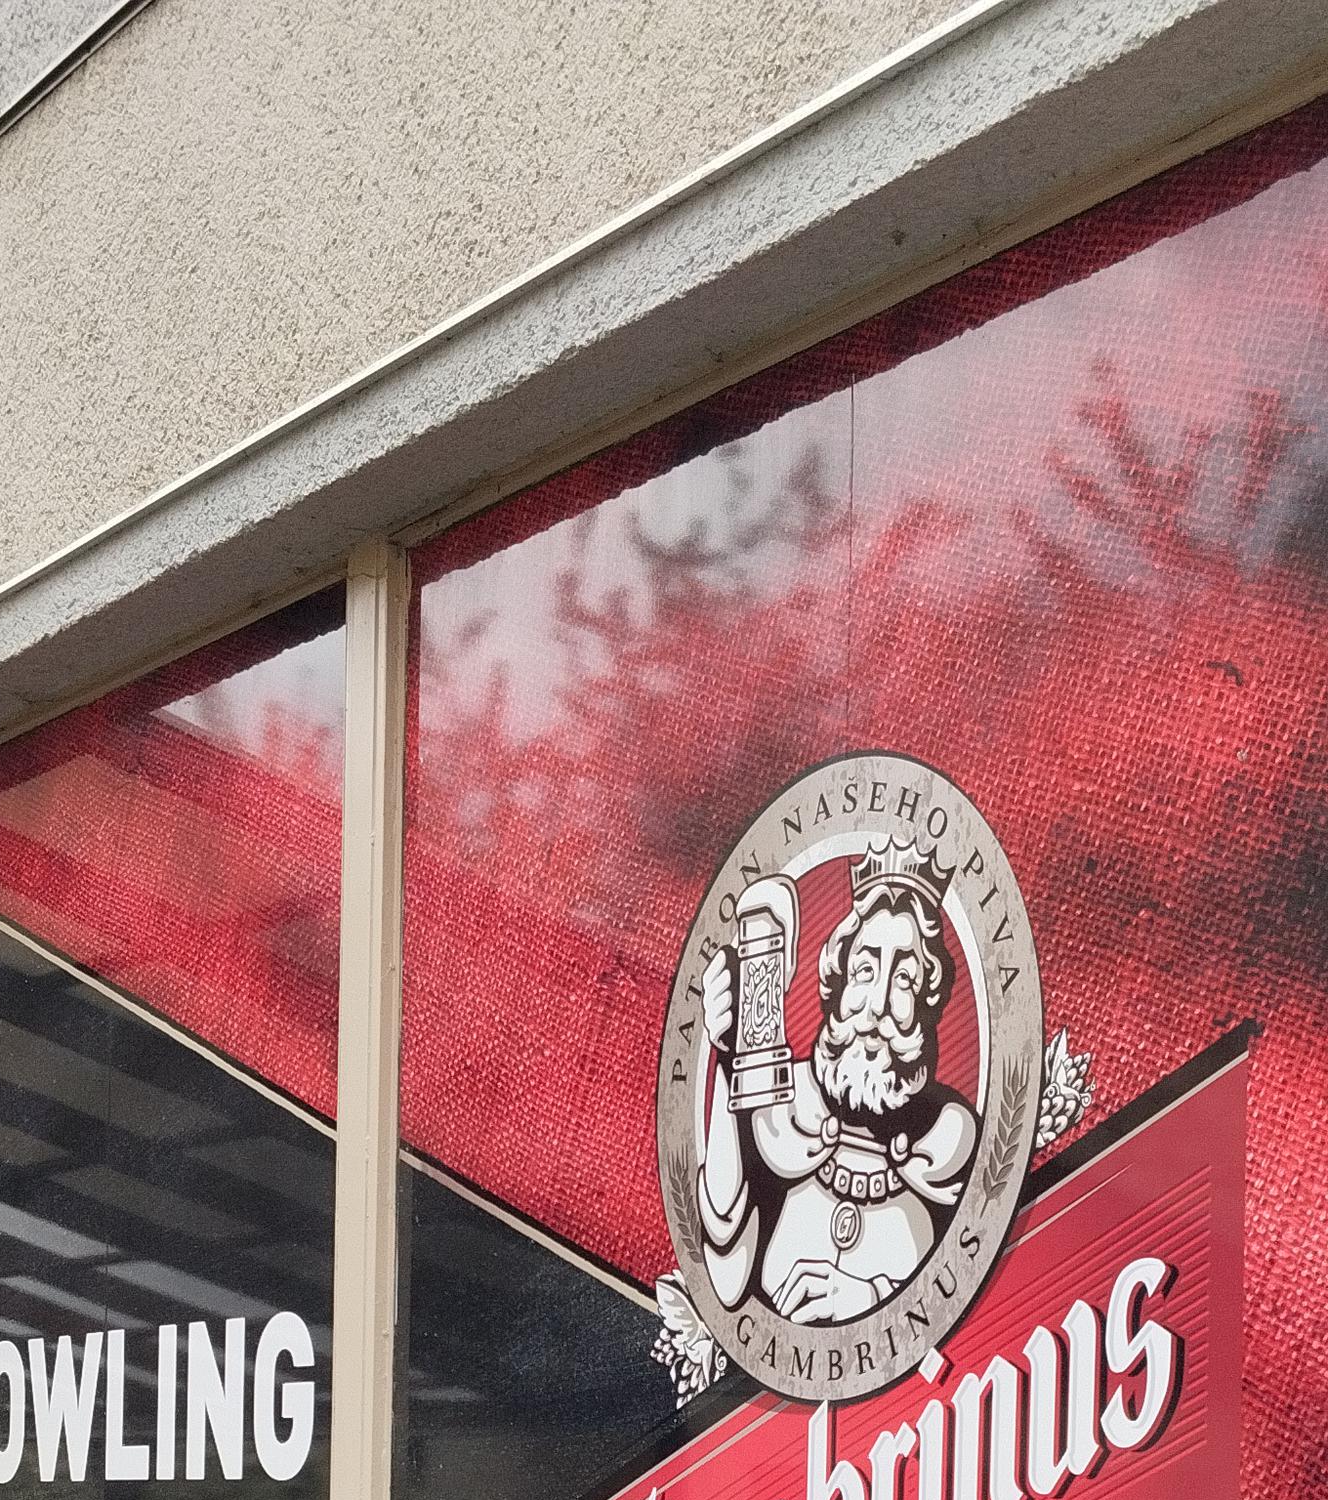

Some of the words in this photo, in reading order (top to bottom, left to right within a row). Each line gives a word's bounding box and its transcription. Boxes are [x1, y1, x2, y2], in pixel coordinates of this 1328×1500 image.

[671, 848, 762, 1085] PATRON
[780, 775, 949, 847] NAŠEHO
[962, 846, 1021, 998] PIVA
[736, 1225, 982, 1382] GAMBRINUS
